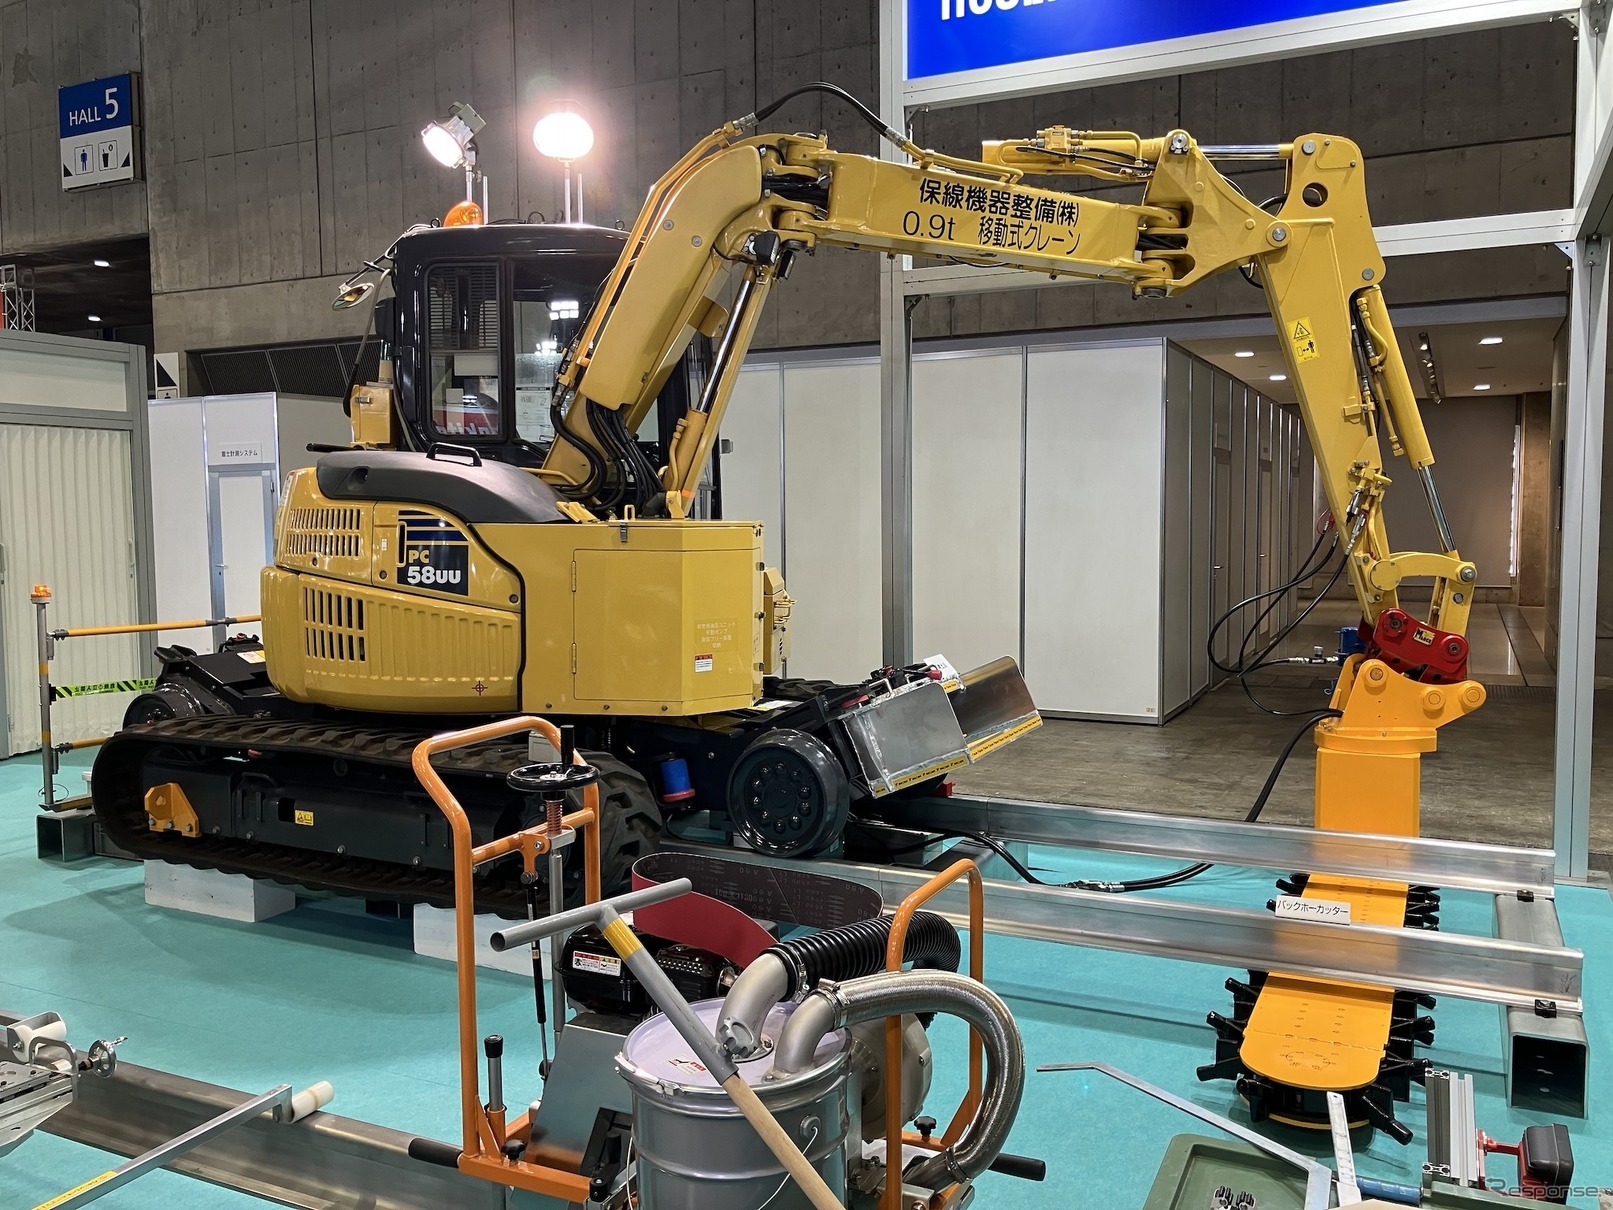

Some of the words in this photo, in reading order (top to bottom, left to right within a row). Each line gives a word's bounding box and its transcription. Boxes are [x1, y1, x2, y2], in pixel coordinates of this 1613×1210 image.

[69, 106, 101, 127] HALL
[105, 87, 119, 119] 5
[919, 177, 1080, 228] 保線機器整備(株)
[903, 210, 956, 241] 0.9t
[977, 215, 1080, 256] 移動式クレーン
[408, 549, 430, 564] PC
[1277, 900, 1349, 916] バックホーカッター
